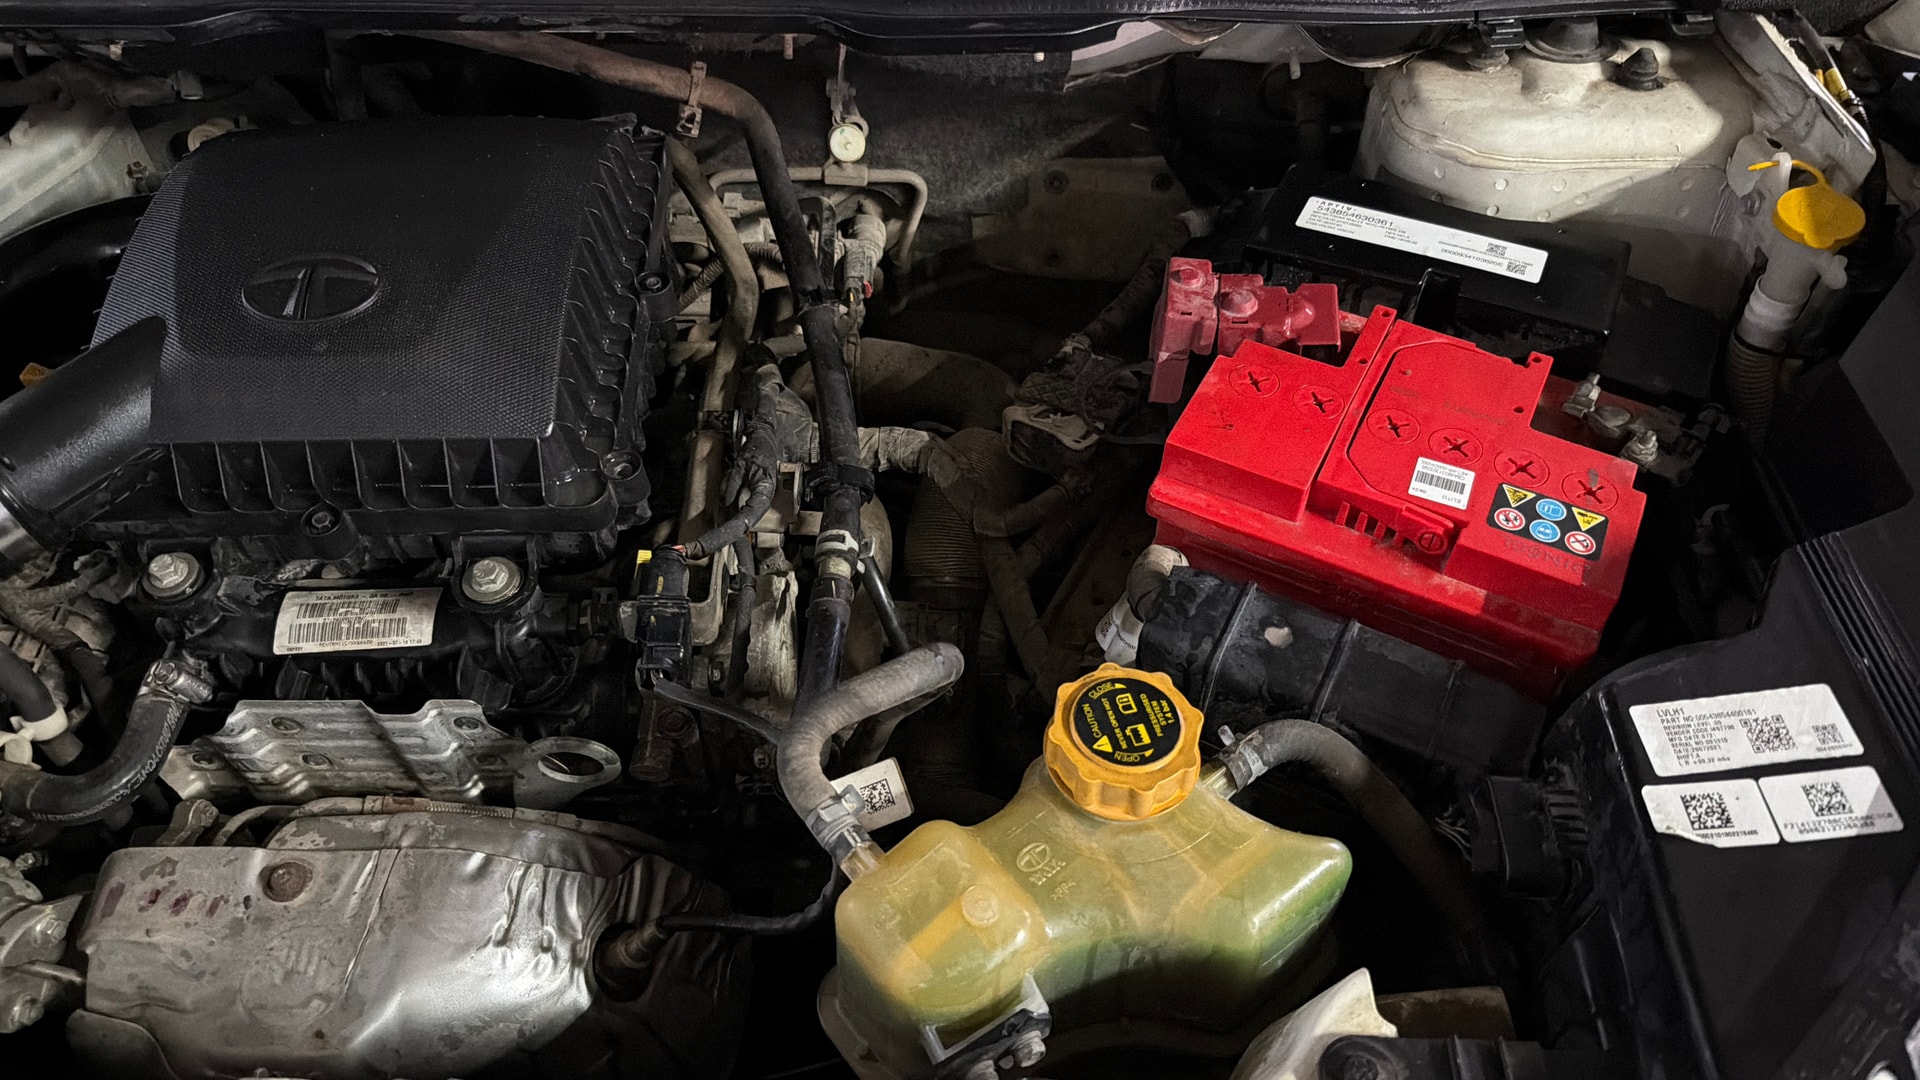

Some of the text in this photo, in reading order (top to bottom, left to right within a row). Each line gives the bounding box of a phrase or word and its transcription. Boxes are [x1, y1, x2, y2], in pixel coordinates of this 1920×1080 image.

[1089, 682, 1113, 699] CLOSE
[1082, 703, 1101, 737] CAUTION
[1101, 697, 1127, 749] NEVER OPEN HOT
[1139, 693, 1163, 736] PRESSURISED
[1151, 700, 1166, 725] SYSTEM
[1159, 698, 1174, 723] 1.4 bar
[1656, 707, 1685, 717] LVLH1
[1114, 752, 1140, 762] OPEN
